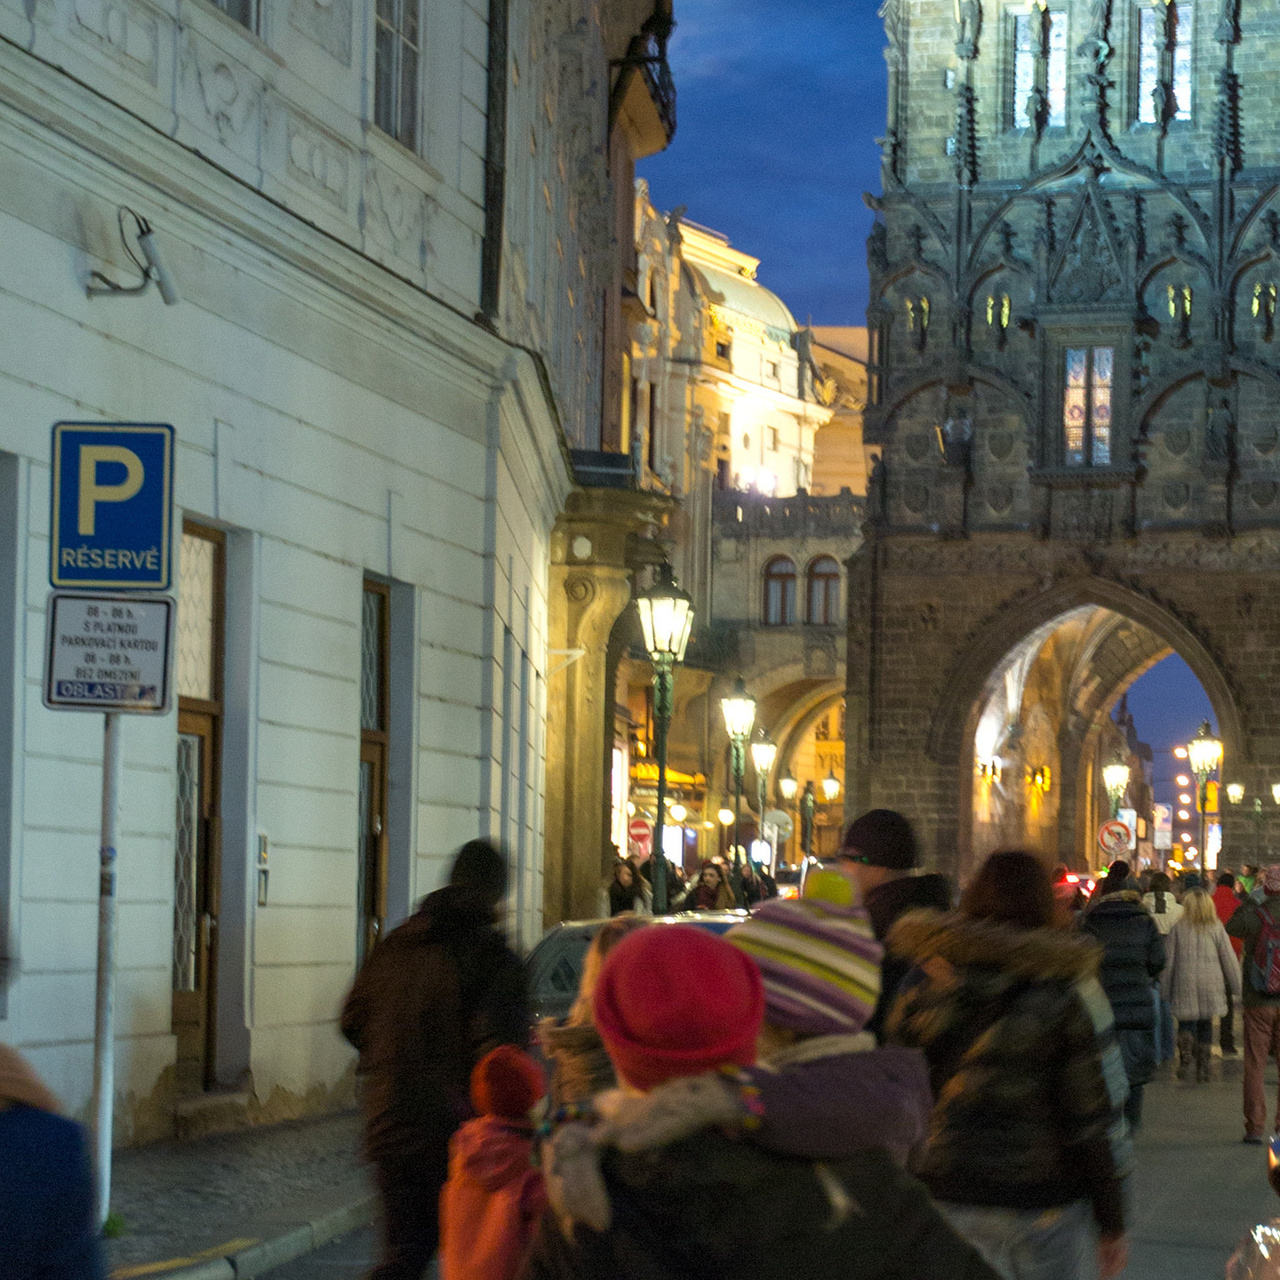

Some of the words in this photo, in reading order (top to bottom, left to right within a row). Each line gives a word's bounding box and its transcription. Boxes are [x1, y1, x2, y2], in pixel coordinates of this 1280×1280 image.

[78, 444, 146, 537] P
[61, 546, 160, 571] RÉSERVÉ
[83, 621, 91, 633] S
[93, 622, 138, 636] PLATNOU
[120, 638, 158, 653] KARTOU
